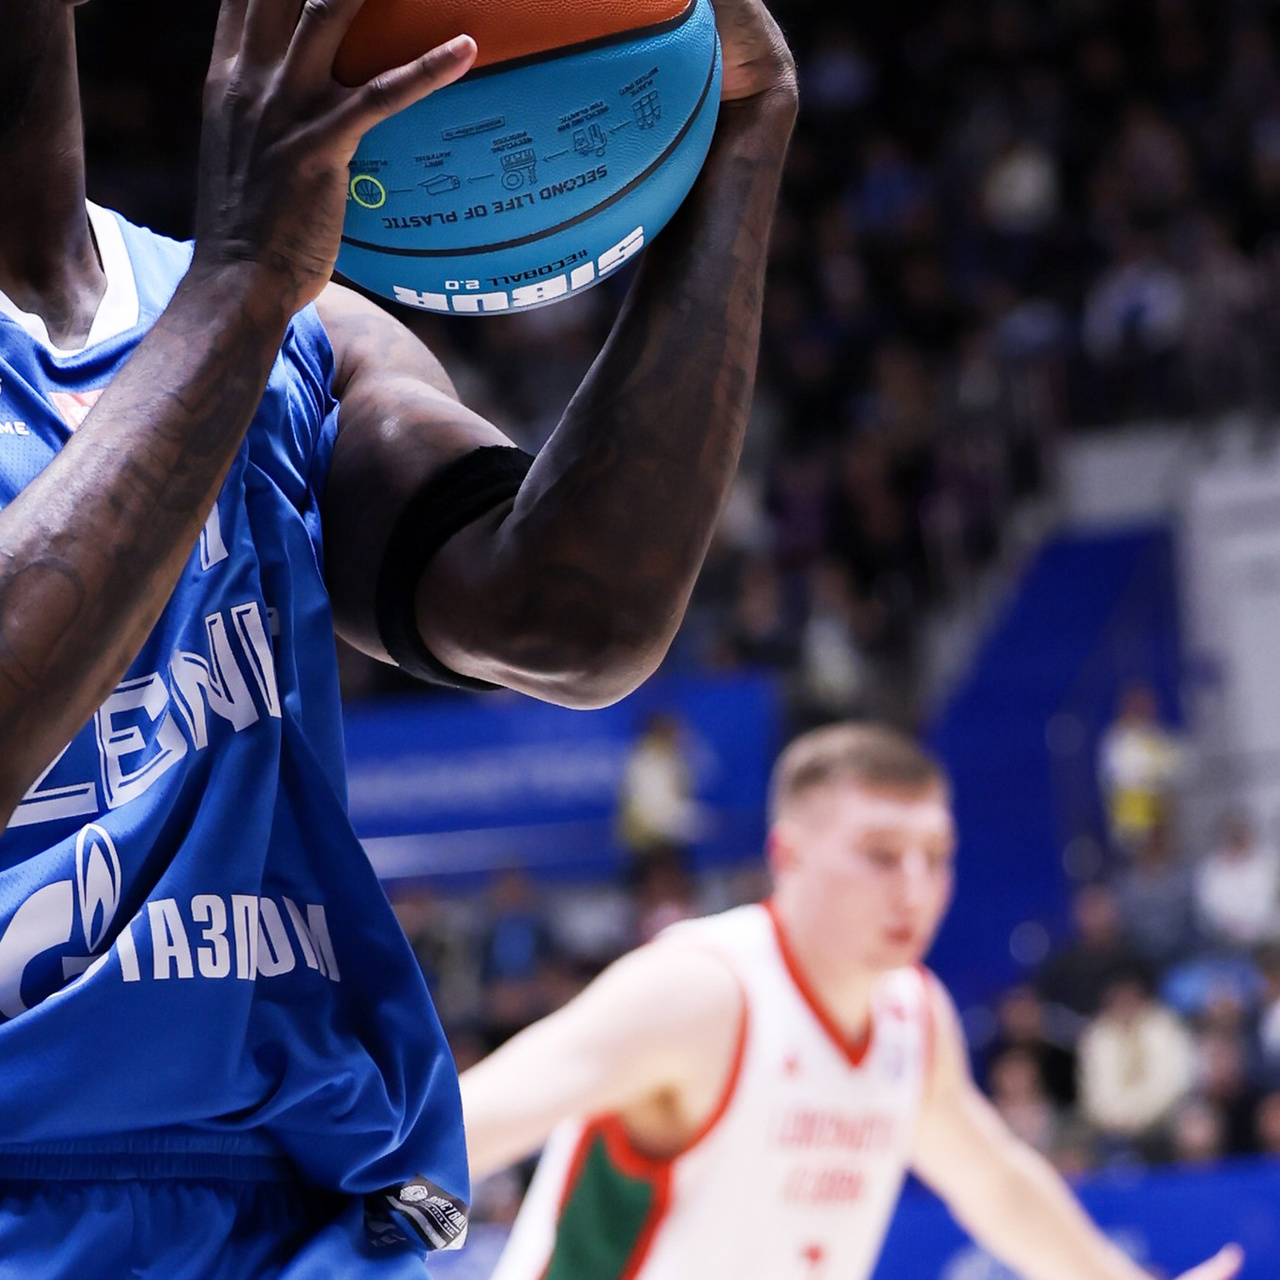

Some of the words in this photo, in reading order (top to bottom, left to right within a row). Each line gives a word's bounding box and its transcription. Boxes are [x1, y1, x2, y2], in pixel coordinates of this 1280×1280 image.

[538, 165, 608, 201] SECOND
[463, 205, 487, 220] OF
[491, 192, 535, 215] LIFE
[381, 210, 458, 229] PLASTIC
[392, 225, 645, 312] SIBUR
[485, 249, 588, 288] #ECOBALL
[444, 279, 480, 290] 2.0
[5, 601, 282, 830] ZENI
